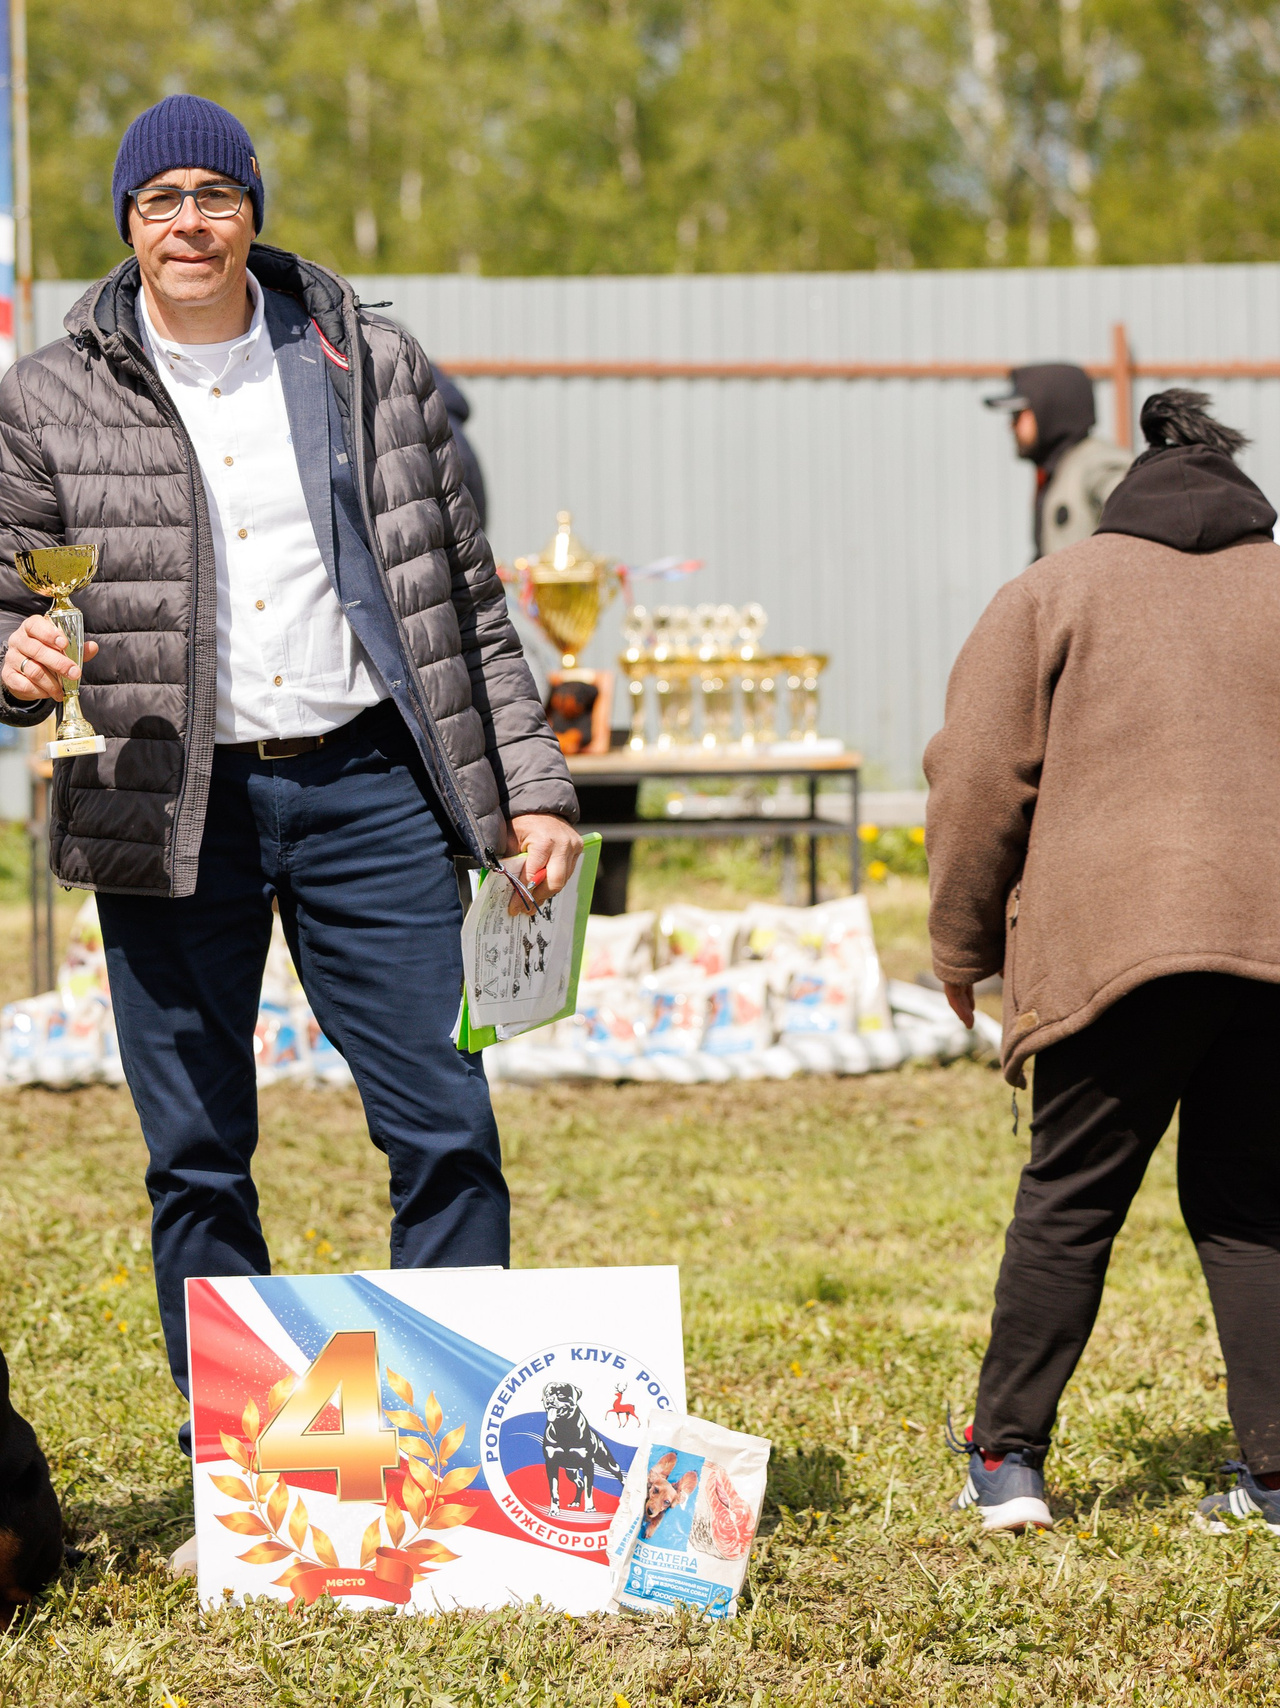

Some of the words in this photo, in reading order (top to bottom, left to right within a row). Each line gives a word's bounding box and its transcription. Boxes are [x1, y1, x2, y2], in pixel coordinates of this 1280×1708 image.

[255, 1329, 400, 1504] 4
[486, 1352, 556, 1463] РОТВЕЙЛЕР
[570, 1348, 627, 1370] КЛУБ
[635, 1370, 673, 1413] РОС
[501, 1494, 608, 1549] НИЖЕГОРОД
[325, 1576, 367, 1589] место
